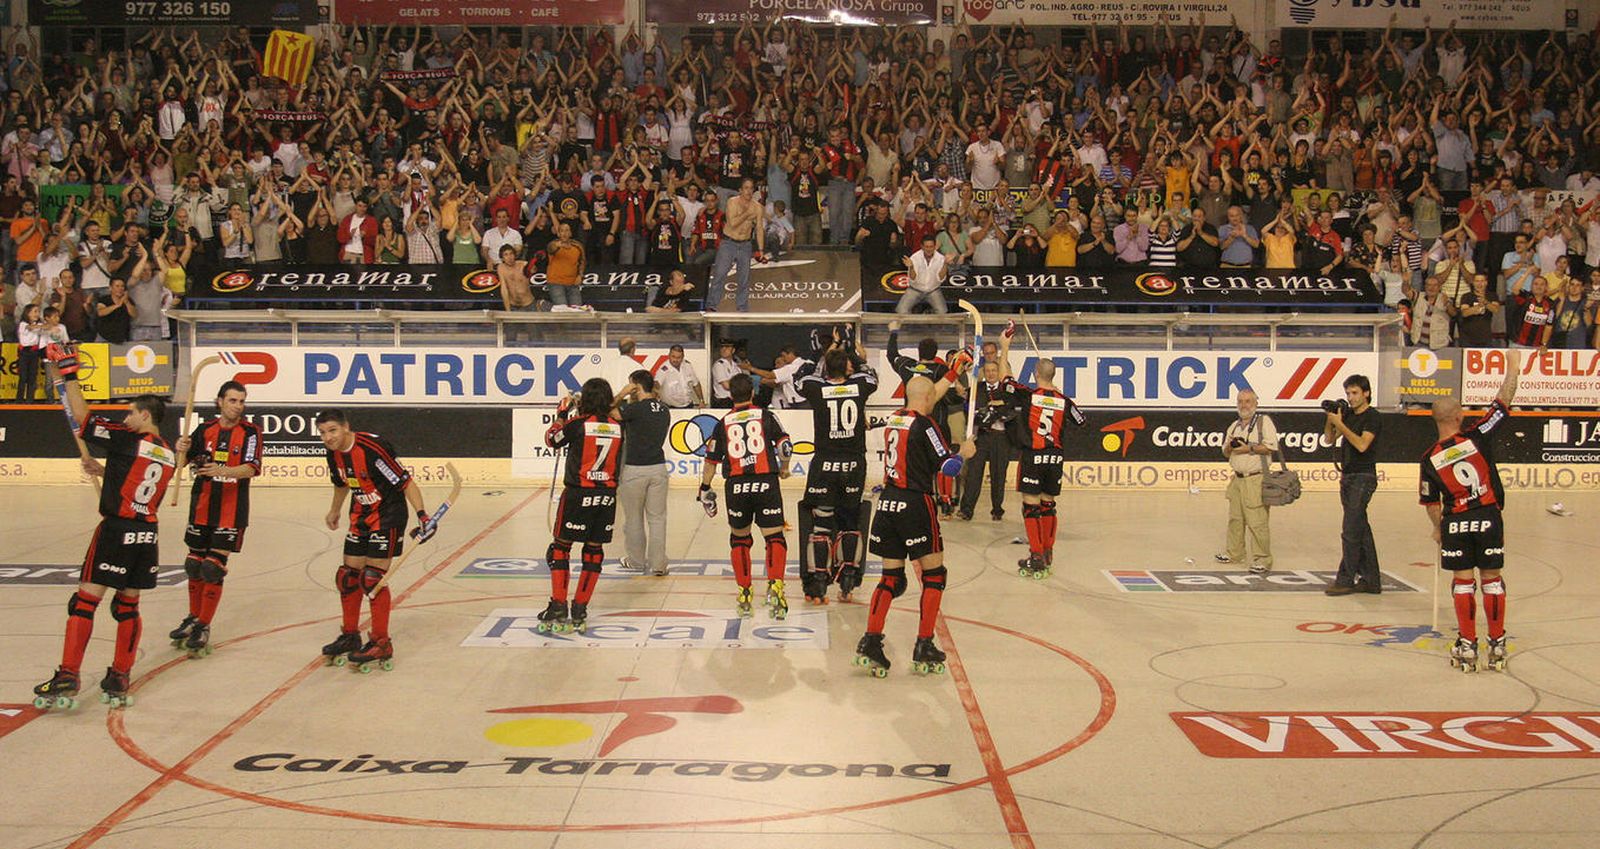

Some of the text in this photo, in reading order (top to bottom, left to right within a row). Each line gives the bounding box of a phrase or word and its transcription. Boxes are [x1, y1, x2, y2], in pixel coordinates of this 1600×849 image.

[126, 2, 230, 15] 977 326 150
[399, 8, 440, 17] GELATS
[460, 7, 511, 17] TORRONS
[881, 0, 923, 13] Grupo
[718, 13, 737, 21] 312
[263, 113, 294, 122] FORÇA
[128, 378, 154, 386] REUS
[304, 353, 585, 397] PATRICK
[1016, 356, 1259, 400] ATRICK
[1410, 379, 1436, 387] REUS
[112, 385, 170, 395] TRANSPORT
[1520, 381, 1587, 390] CONSTRUCCIONES
[827, 399, 858, 432] 10
[1037, 410, 1055, 436] 5
[727, 420, 765, 459] 88
[1152, 426, 1224, 447] Caixa
[590, 438, 613, 472] 7
[886, 429, 899, 467] 3
[822, 461, 858, 472] BEEP
[1034, 455, 1063, 465] BEEP
[135, 462, 163, 504] 8
[1063, 465, 1158, 487] NGULLO
[1453, 460, 1481, 494] 9
[733, 482, 770, 494] BEEP
[1449, 520, 1492, 534] BEEP
[1183, 715, 1600, 754] VIRGI
[233, 751, 952, 784] Caixa Tarragona
